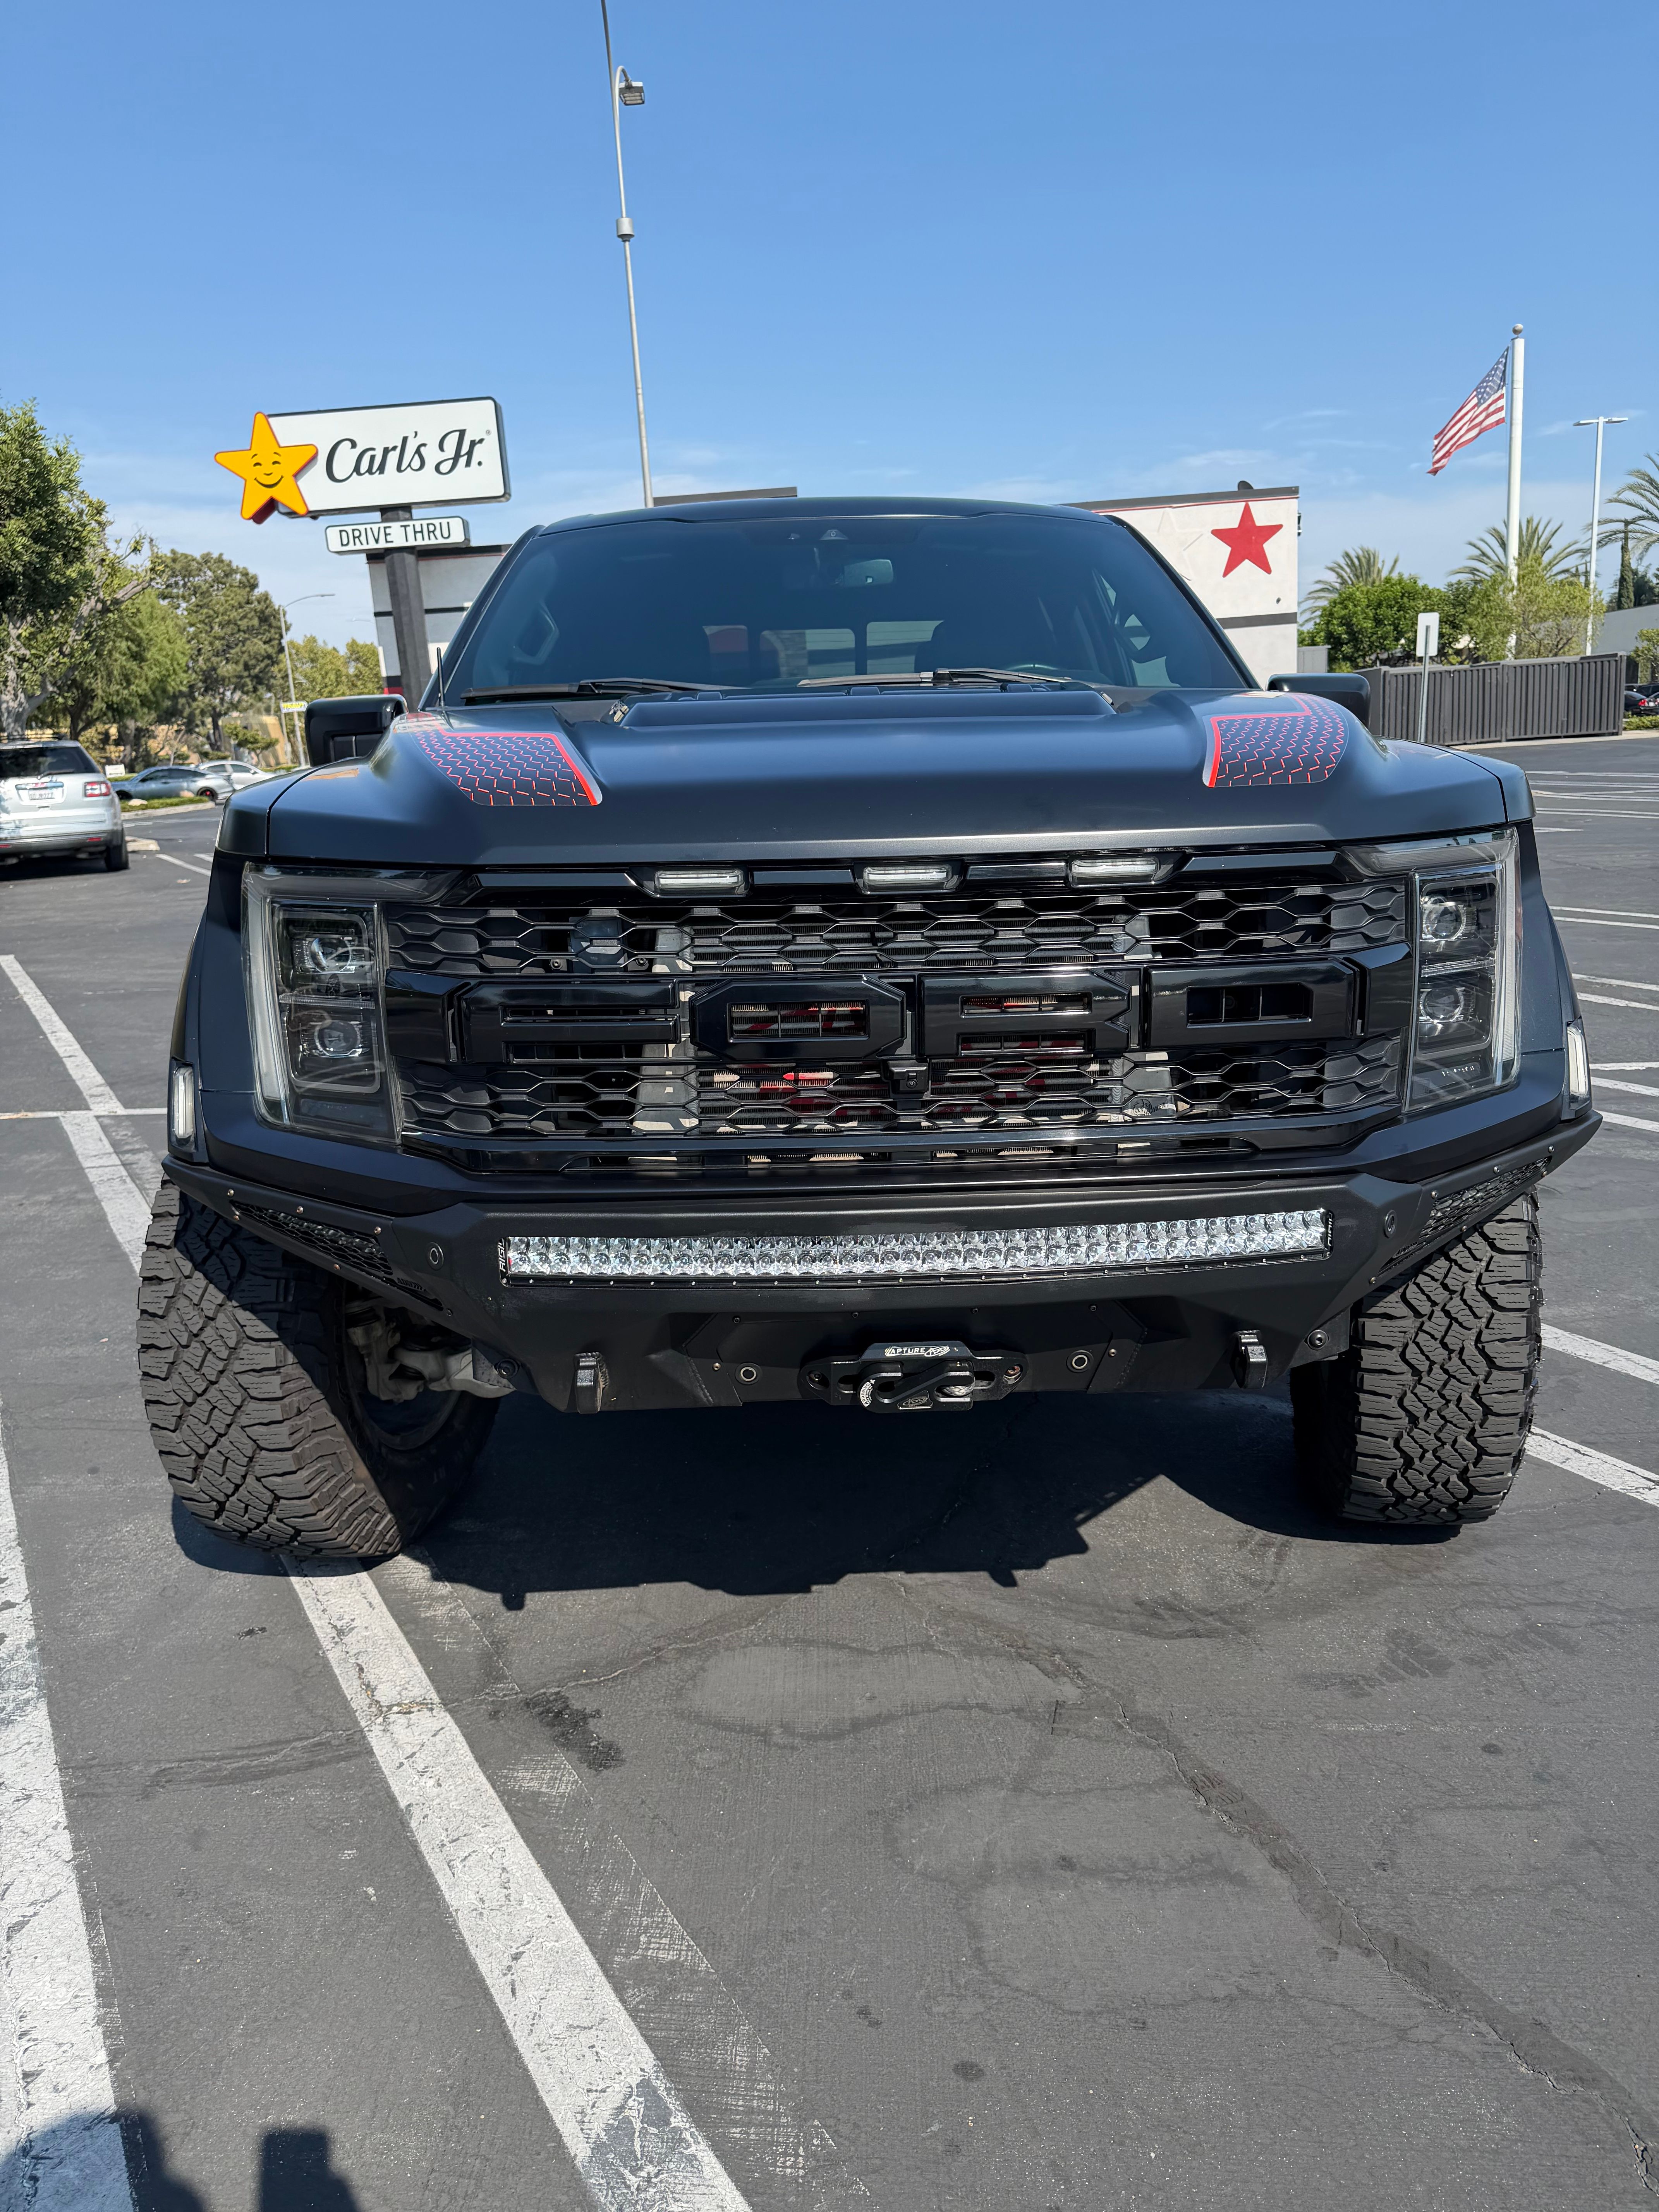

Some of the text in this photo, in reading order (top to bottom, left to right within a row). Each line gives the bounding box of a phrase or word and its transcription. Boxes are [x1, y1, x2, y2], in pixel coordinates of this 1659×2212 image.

[326, 429, 485, 483] Carl's Jr.
[339, 521, 451, 547] DRIVE THRU
[461, 960, 1353, 1064] FORD
